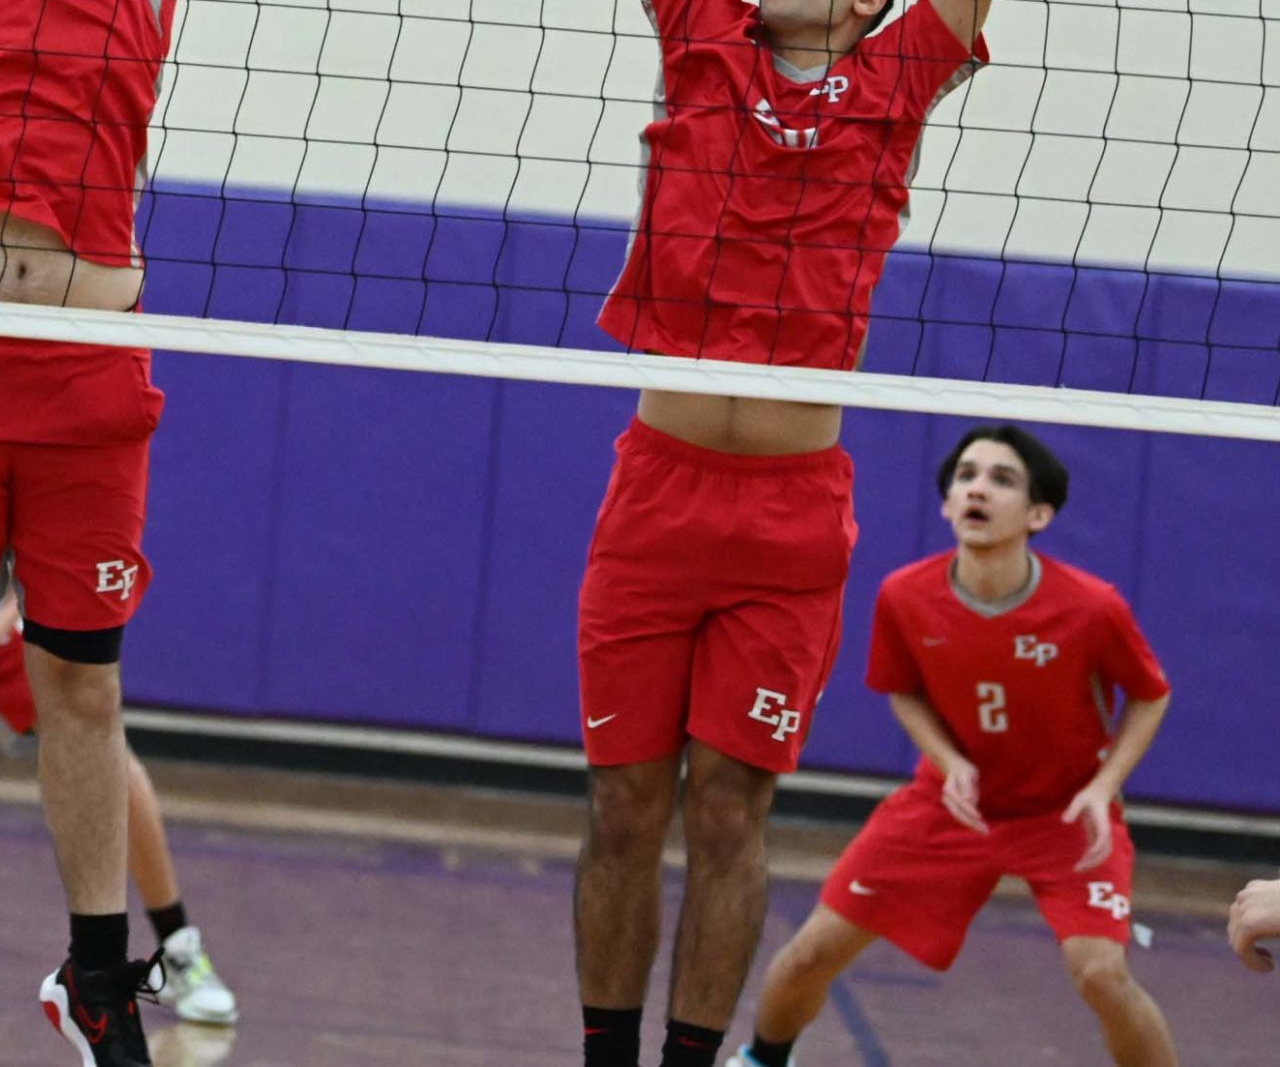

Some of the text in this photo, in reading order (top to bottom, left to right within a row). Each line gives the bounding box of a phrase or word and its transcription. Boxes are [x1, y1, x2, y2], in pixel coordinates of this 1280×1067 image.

[1014, 634, 1058, 667] EP
[748, 687, 800, 742] EP
[977, 682, 1008, 733] 2
[1088, 881, 1130, 920] EP
